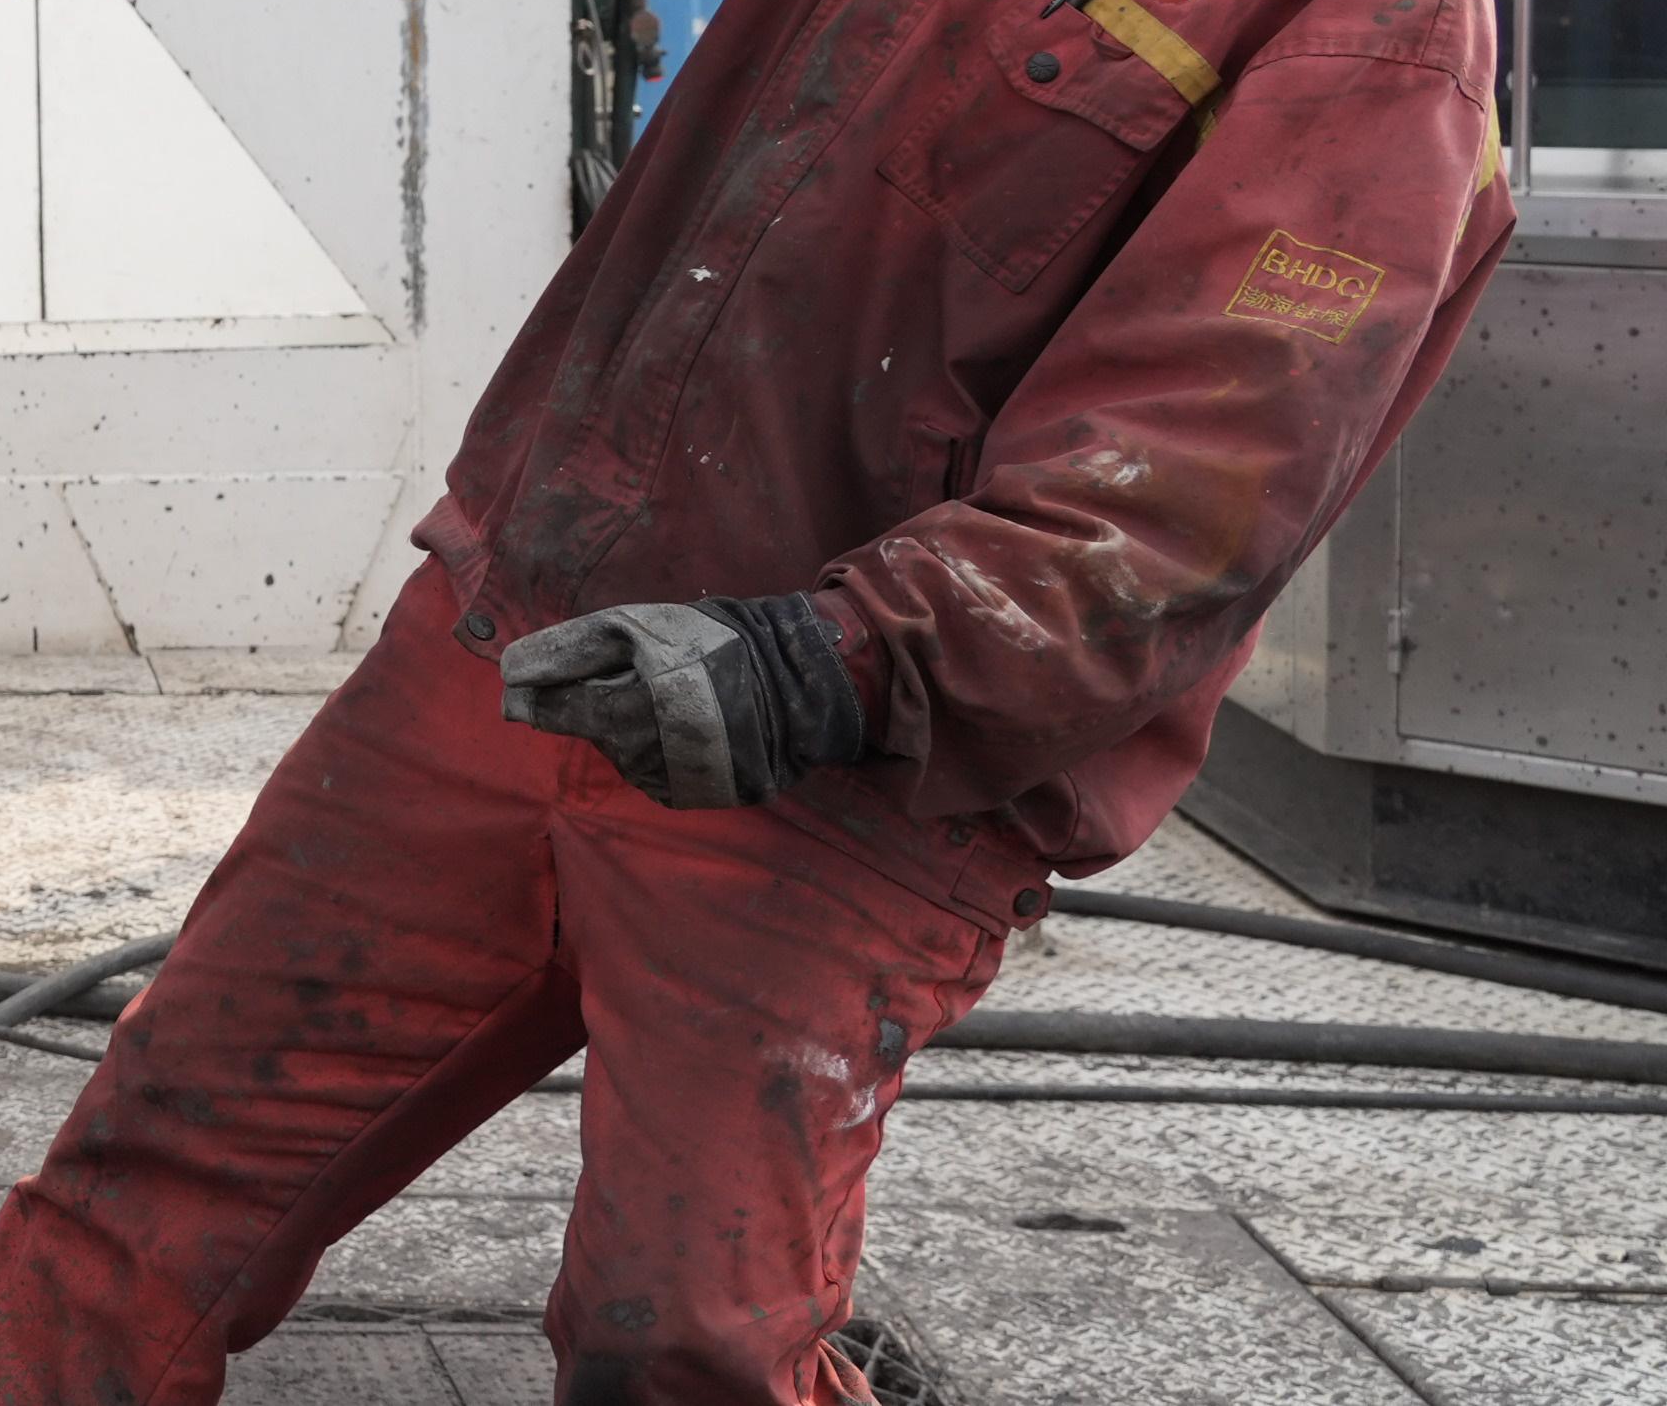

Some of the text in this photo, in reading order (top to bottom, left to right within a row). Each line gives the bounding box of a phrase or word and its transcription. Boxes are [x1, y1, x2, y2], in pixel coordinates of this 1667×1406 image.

[1261, 248, 1367, 298] BHDC
[1240, 286, 1348, 326] 渤海钻探
